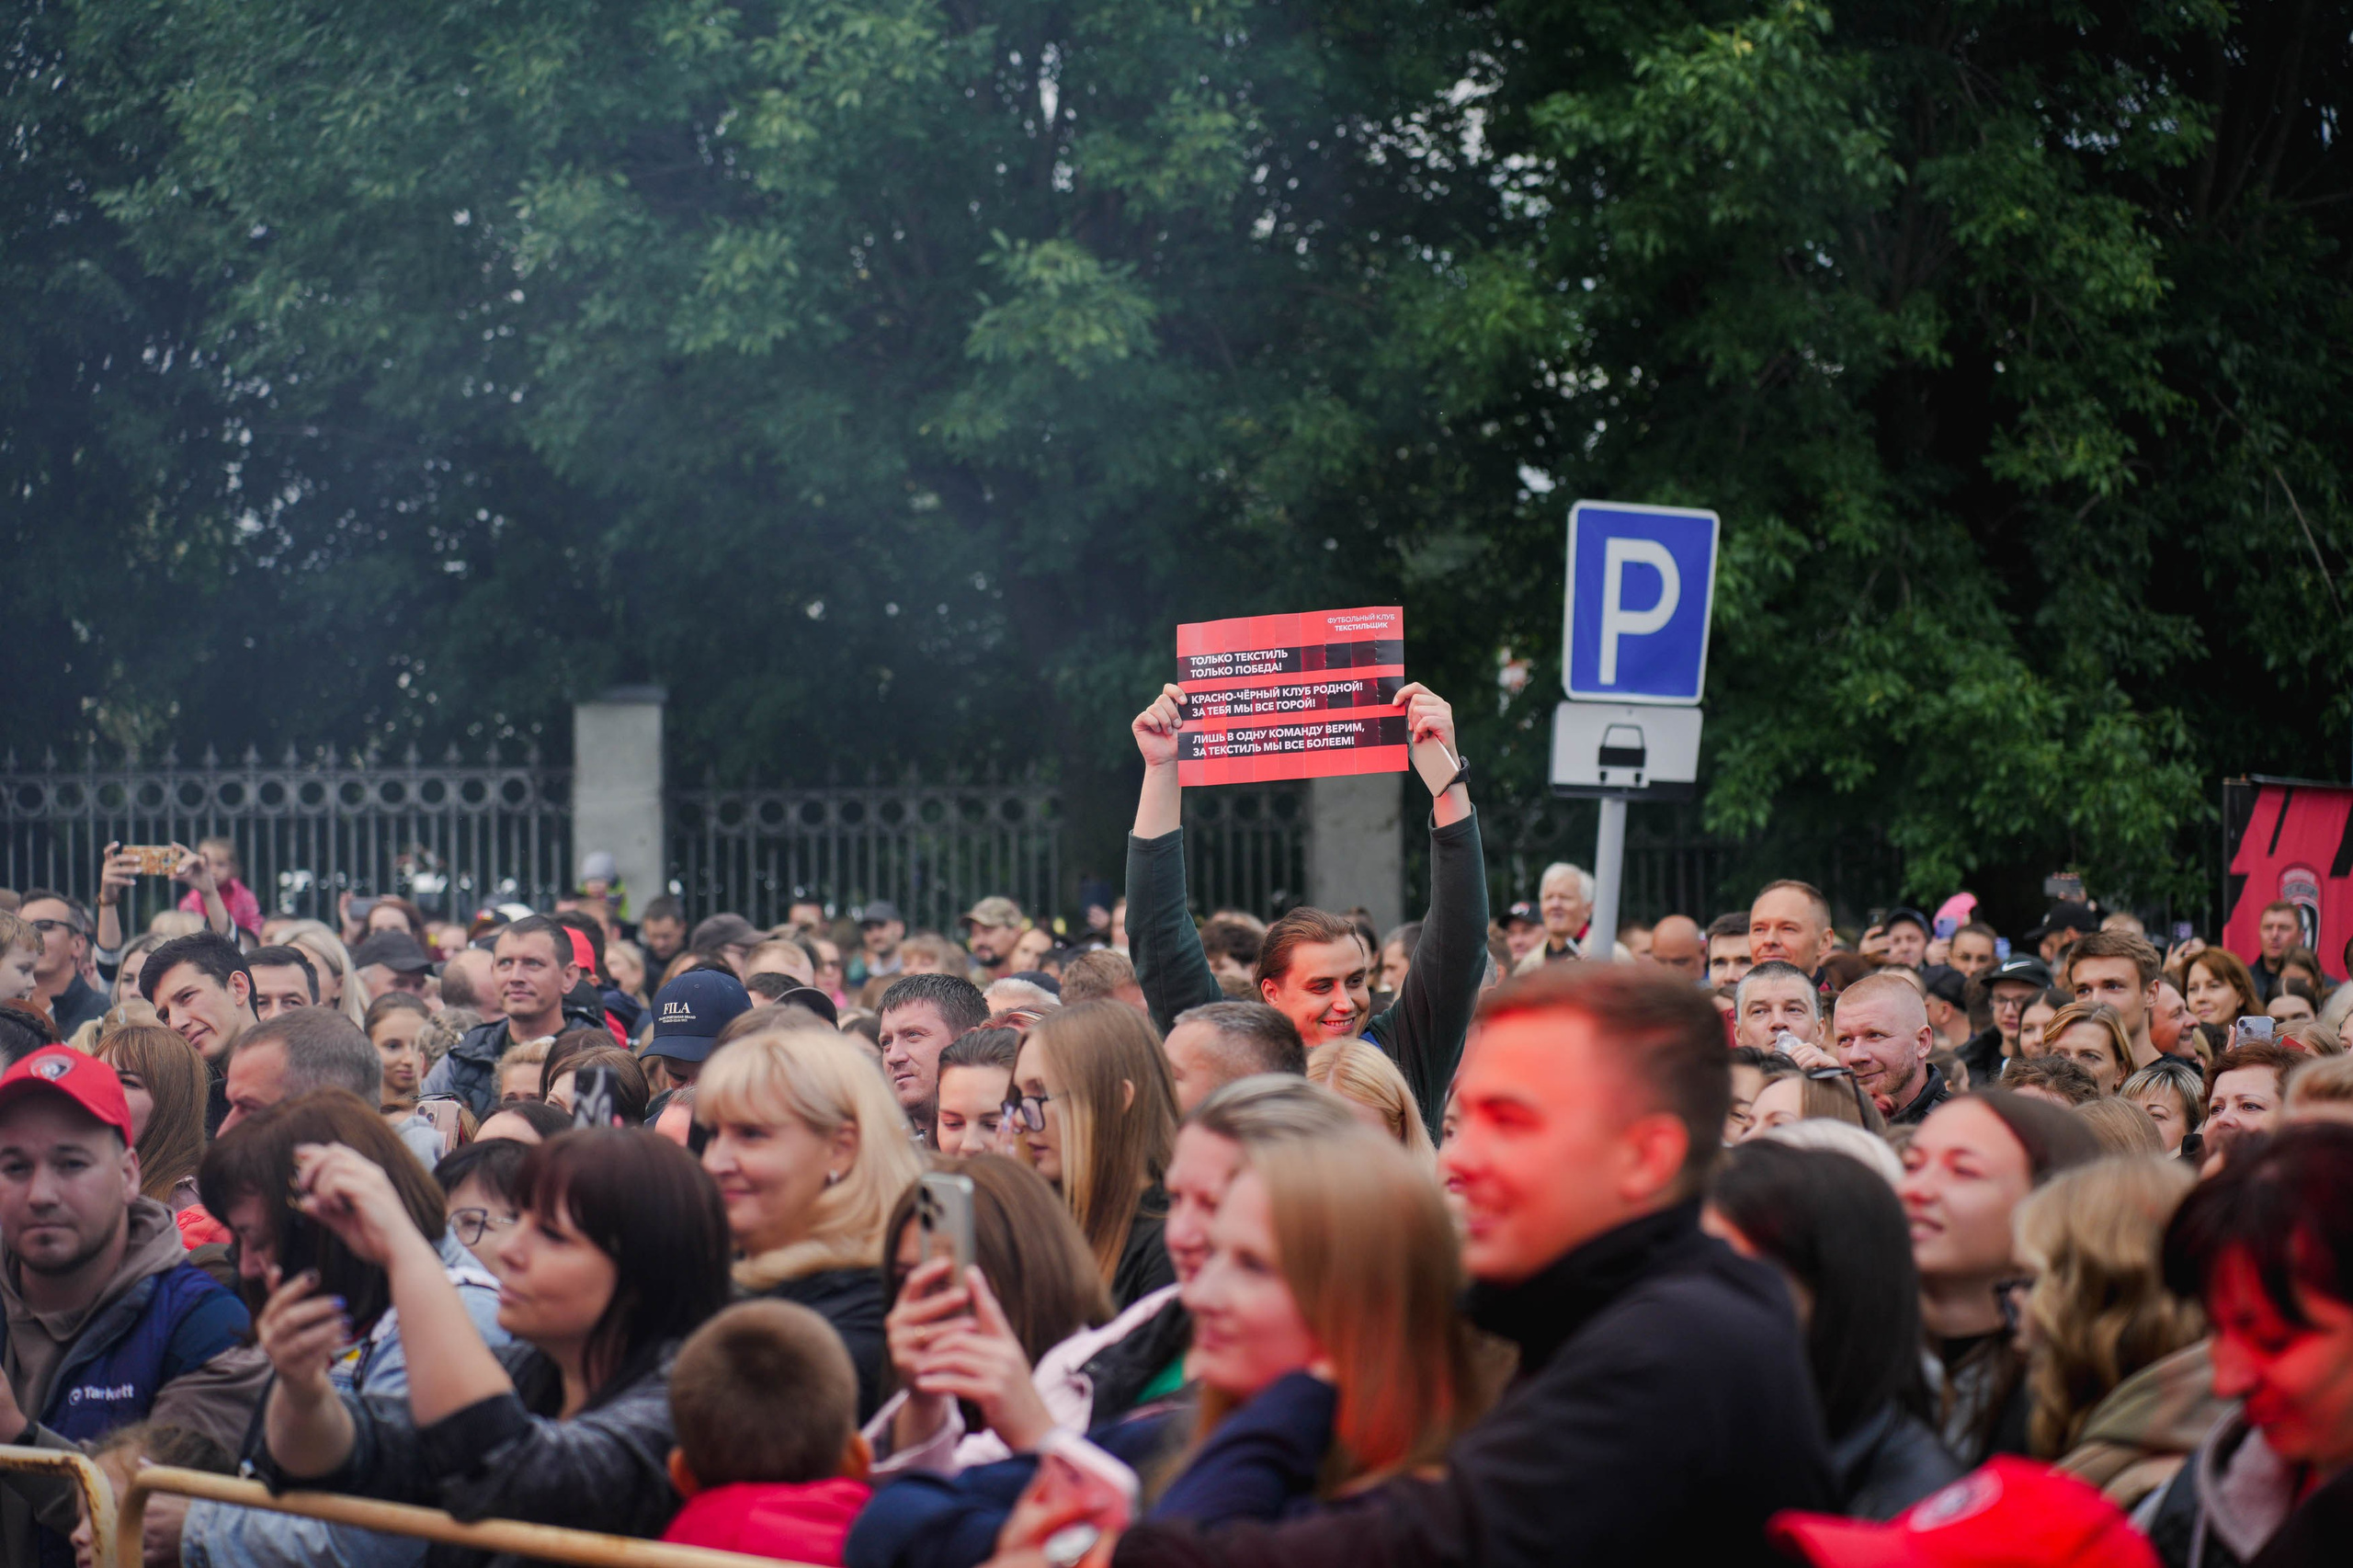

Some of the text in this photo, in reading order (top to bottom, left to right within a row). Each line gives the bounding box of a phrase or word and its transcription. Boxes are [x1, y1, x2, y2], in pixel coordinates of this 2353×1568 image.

[1327, 613, 1375, 624] ФУТБОЛЬНЫЙ
[1598, 537, 1681, 685] P
[1335, 622, 1388, 631] ТЕКСТИЛЬЩИК
[1190, 649, 1288, 665] ТОЛЬКО ТЕКСТИЛЬ
[1190, 662, 1282, 678] ТОЛЬКО ПОБЕДА!
[1191, 680, 1363, 704] КРАСНО-ЧЁРНЫЙ КЛУБ РОДНОЙ!
[1192, 697, 1316, 717] ЗА ТЕБЯ МЫ ВСЕ ГОРОЙ!
[1192, 722, 1365, 744] ЛИШЬ В ОДНУ КОМАНДУ ВЕРИМ,
[1193, 736, 1355, 757] ЗА ТЕКСТИЛЬ МЫ ВСЕ БОЛЕЕМ!
[663, 1002, 691, 1015] FILA
